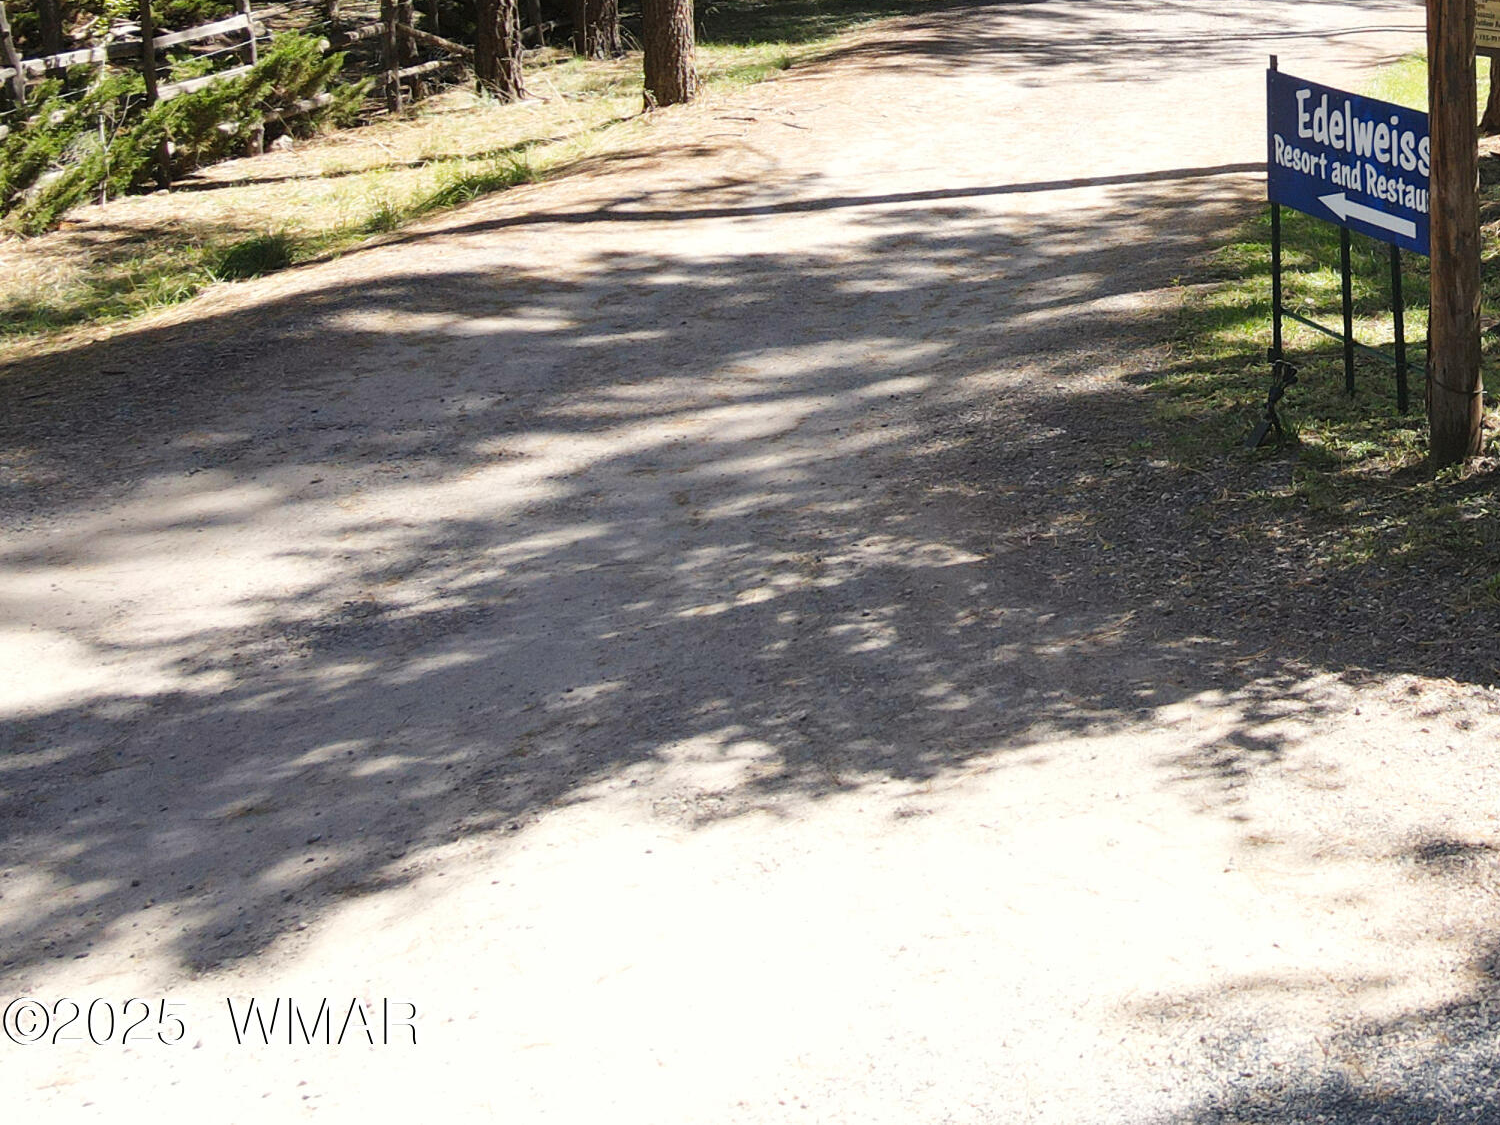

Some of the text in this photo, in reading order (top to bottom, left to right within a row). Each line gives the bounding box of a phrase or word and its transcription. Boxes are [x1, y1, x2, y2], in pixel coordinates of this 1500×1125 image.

[1274, 134, 1430, 213] Resort and Restau
[1296, 89, 1430, 177] Edelweiss
